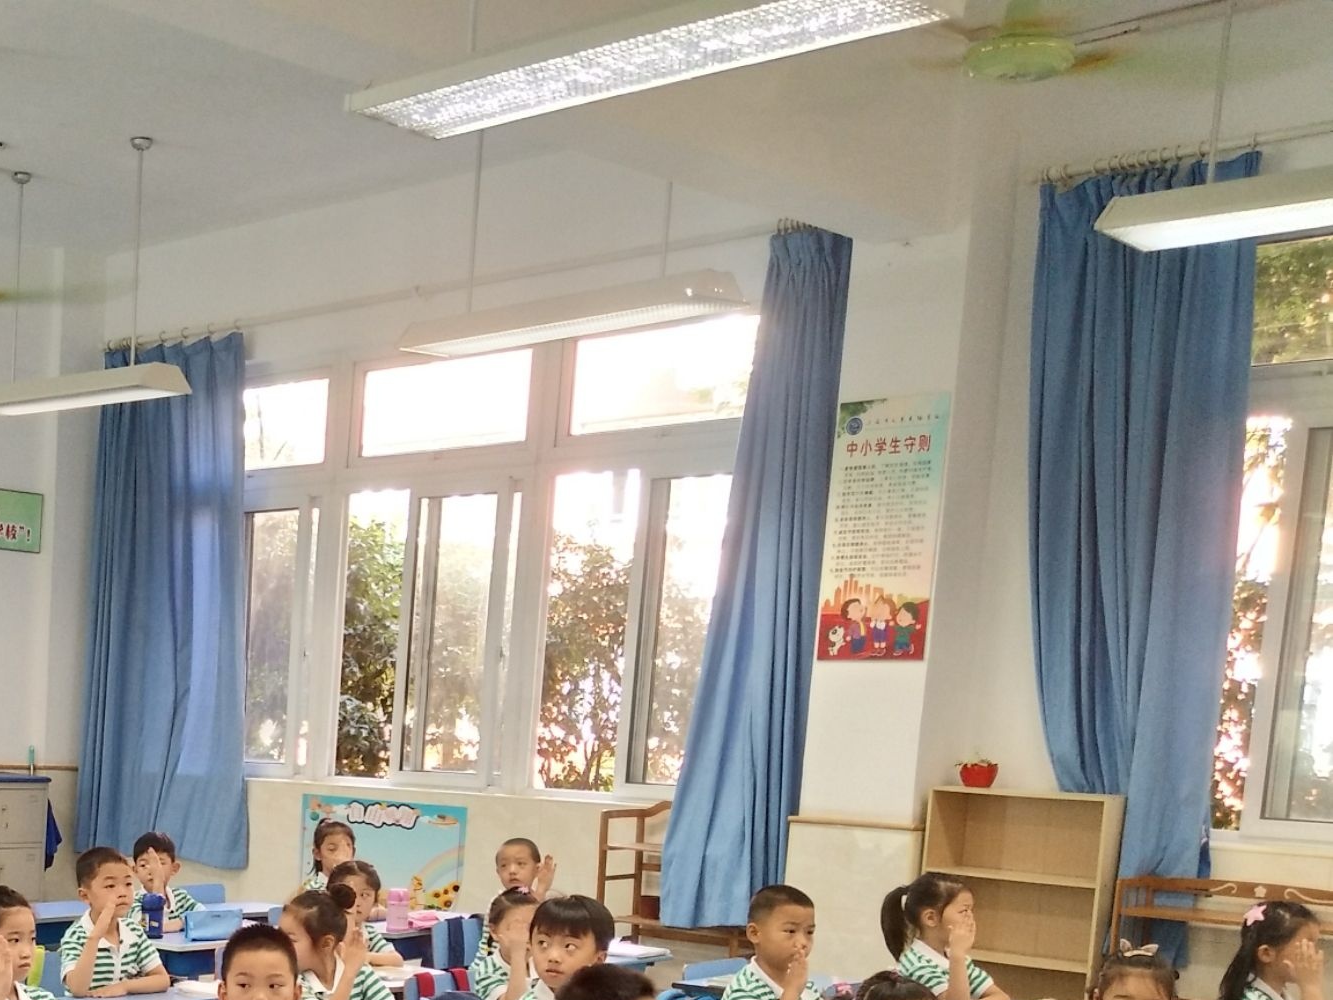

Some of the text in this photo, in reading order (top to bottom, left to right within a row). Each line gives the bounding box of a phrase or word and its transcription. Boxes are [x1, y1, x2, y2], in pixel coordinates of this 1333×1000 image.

[846, 434, 932, 458] 中小学生守则
